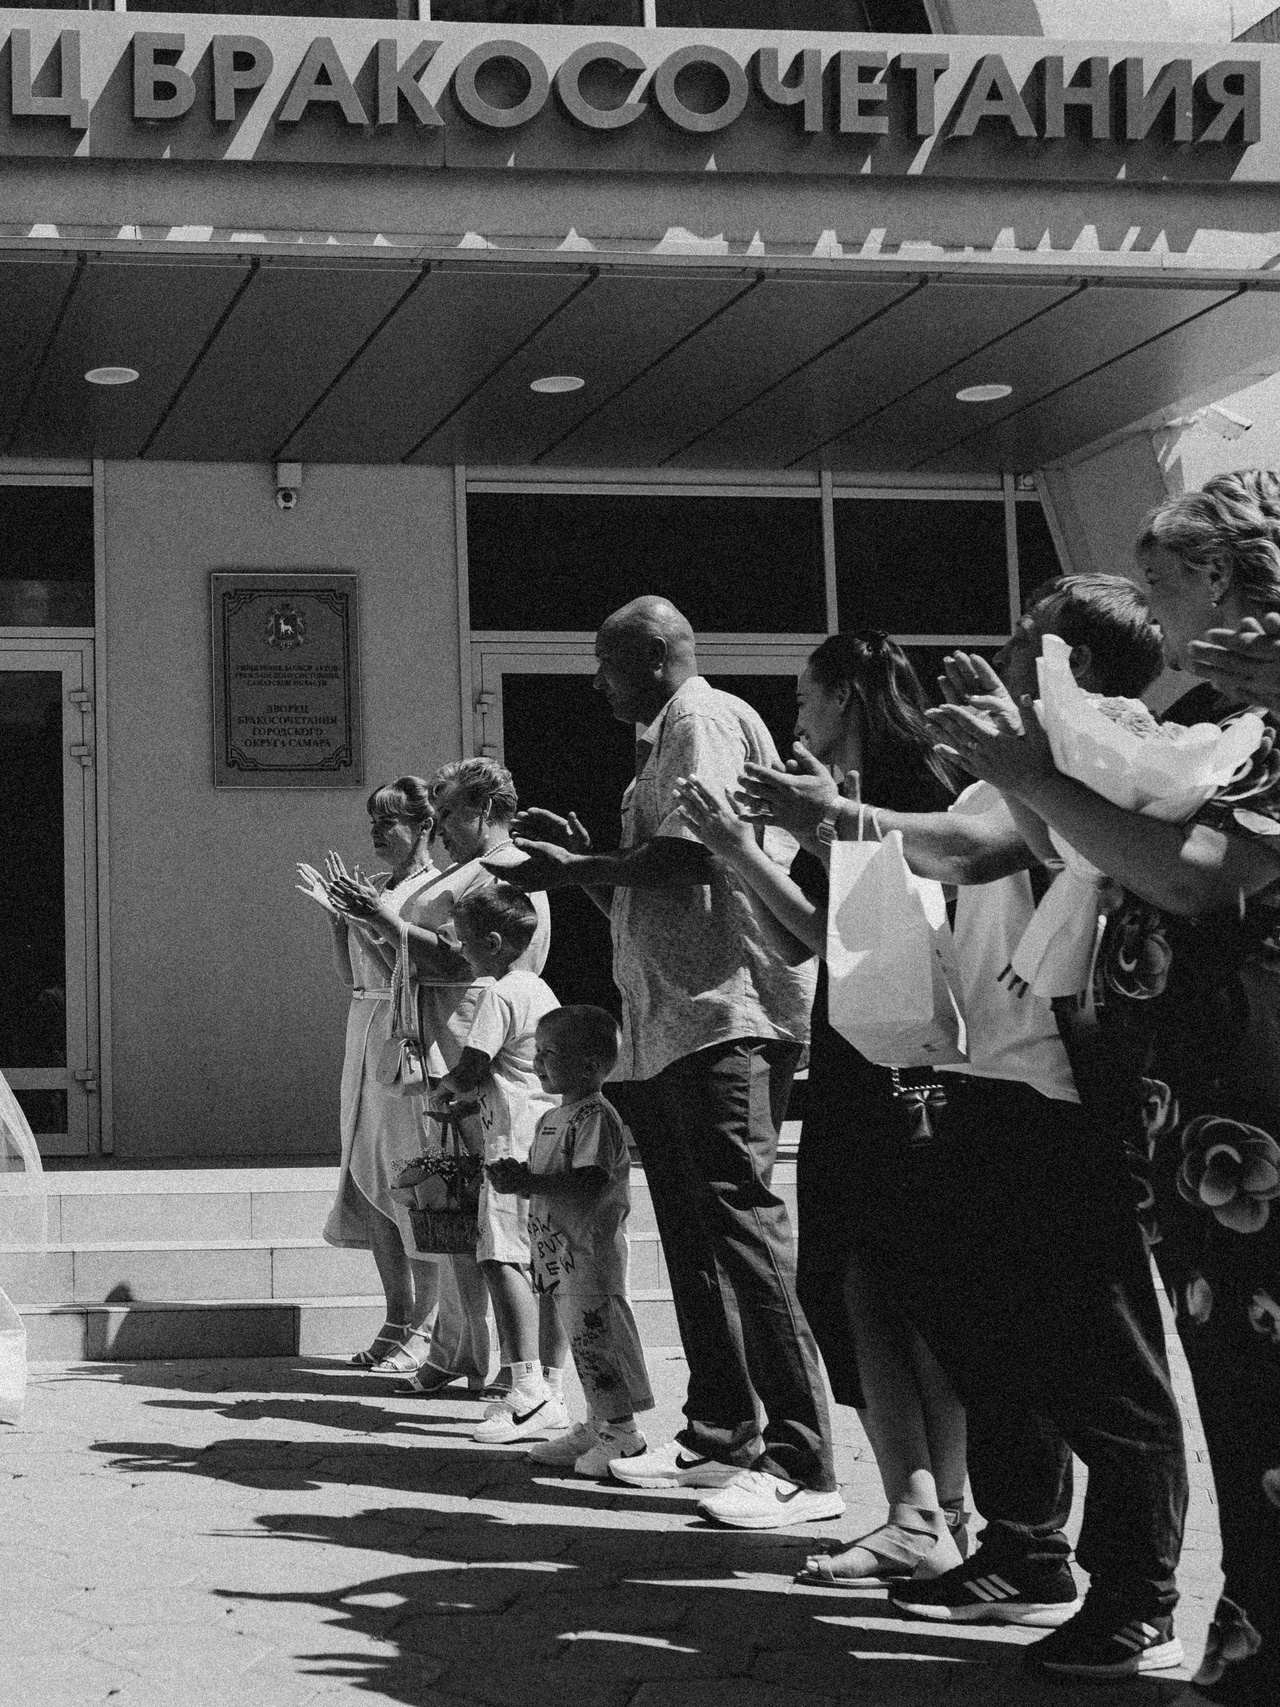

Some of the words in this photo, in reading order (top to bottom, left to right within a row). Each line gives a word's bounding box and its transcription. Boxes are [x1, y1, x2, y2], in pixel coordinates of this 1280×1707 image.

[133, 30, 1262, 142] БРАКОСОЧЕТАНИЯ
[266, 704, 309, 714] ДВОРЕЦ
[238, 716, 338, 725] БРАКОСОЧЕТАНИЯ
[252, 727, 324, 737] ГОРОДСКОГО
[244, 738, 286, 748] ОКРУГА
[288, 738, 332, 748] САМАРА
